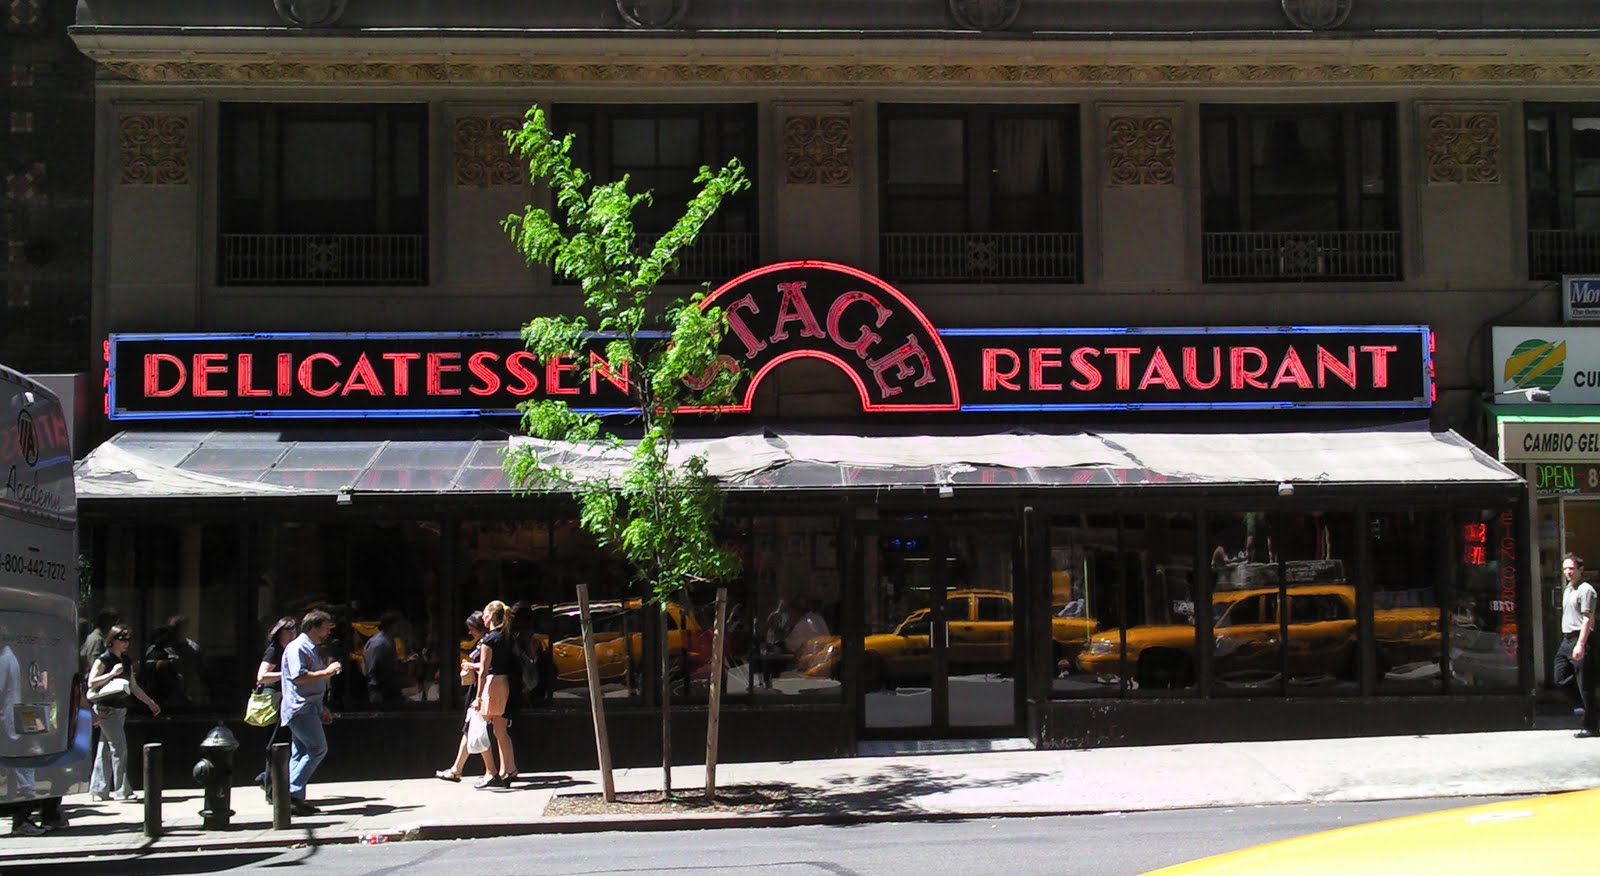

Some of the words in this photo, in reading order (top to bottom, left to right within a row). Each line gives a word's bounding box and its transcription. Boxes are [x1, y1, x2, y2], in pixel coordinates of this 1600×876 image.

[681, 280, 936, 399] STAGE
[143, 350, 629, 398] DELICATESSEN
[981, 344, 1398, 391] RESTAURANT
[6, 464, 62, 511] Academy
[1536, 465, 1575, 488] OPEN
